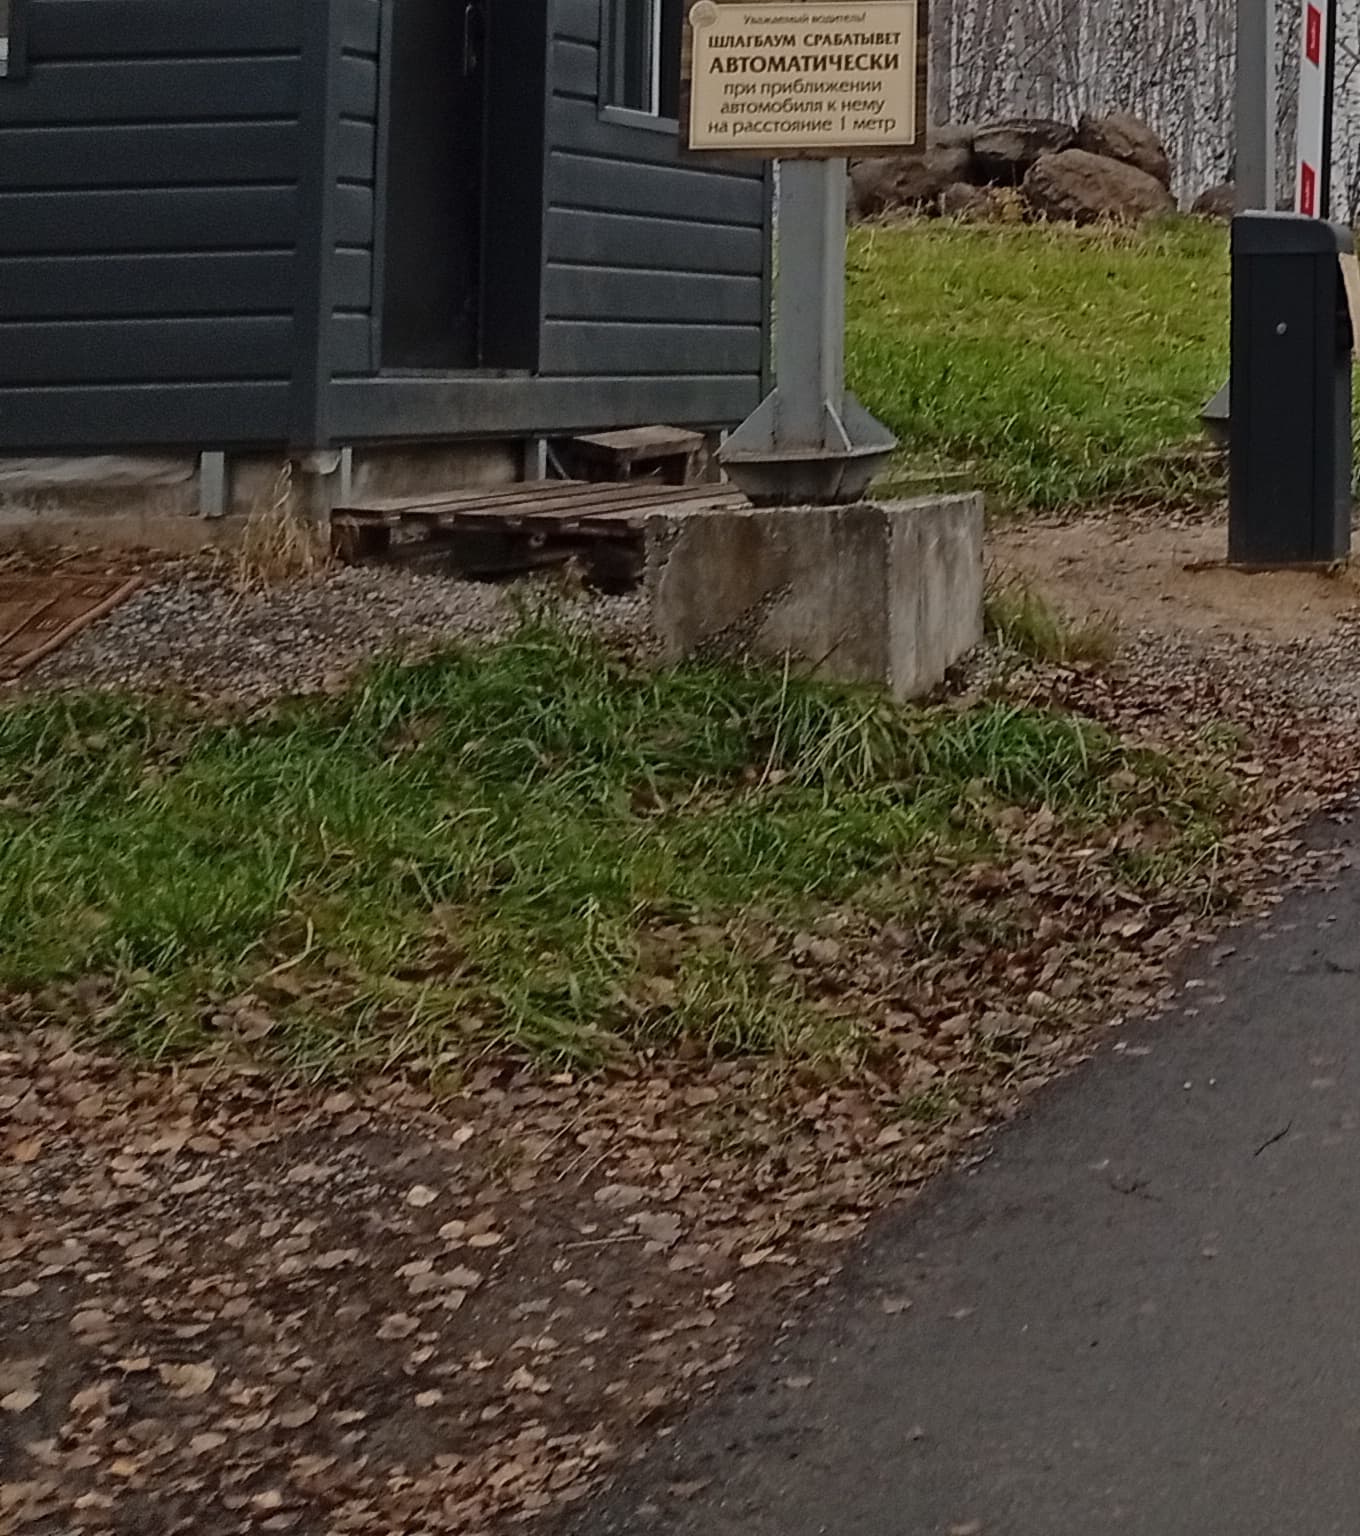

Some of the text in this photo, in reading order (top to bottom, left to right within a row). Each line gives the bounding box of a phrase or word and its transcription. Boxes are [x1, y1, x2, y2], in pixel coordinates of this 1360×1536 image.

[708, 32, 902, 49] ШЛАГБАУМ СРАБАТЫВЕТ
[708, 53, 899, 74] АВТОМАТИЧЕСКИ
[724, 78, 882, 98] при приближении
[720, 97, 885, 115] автомобиля к нему
[708, 116, 896, 137] на расстояние 1 метр
